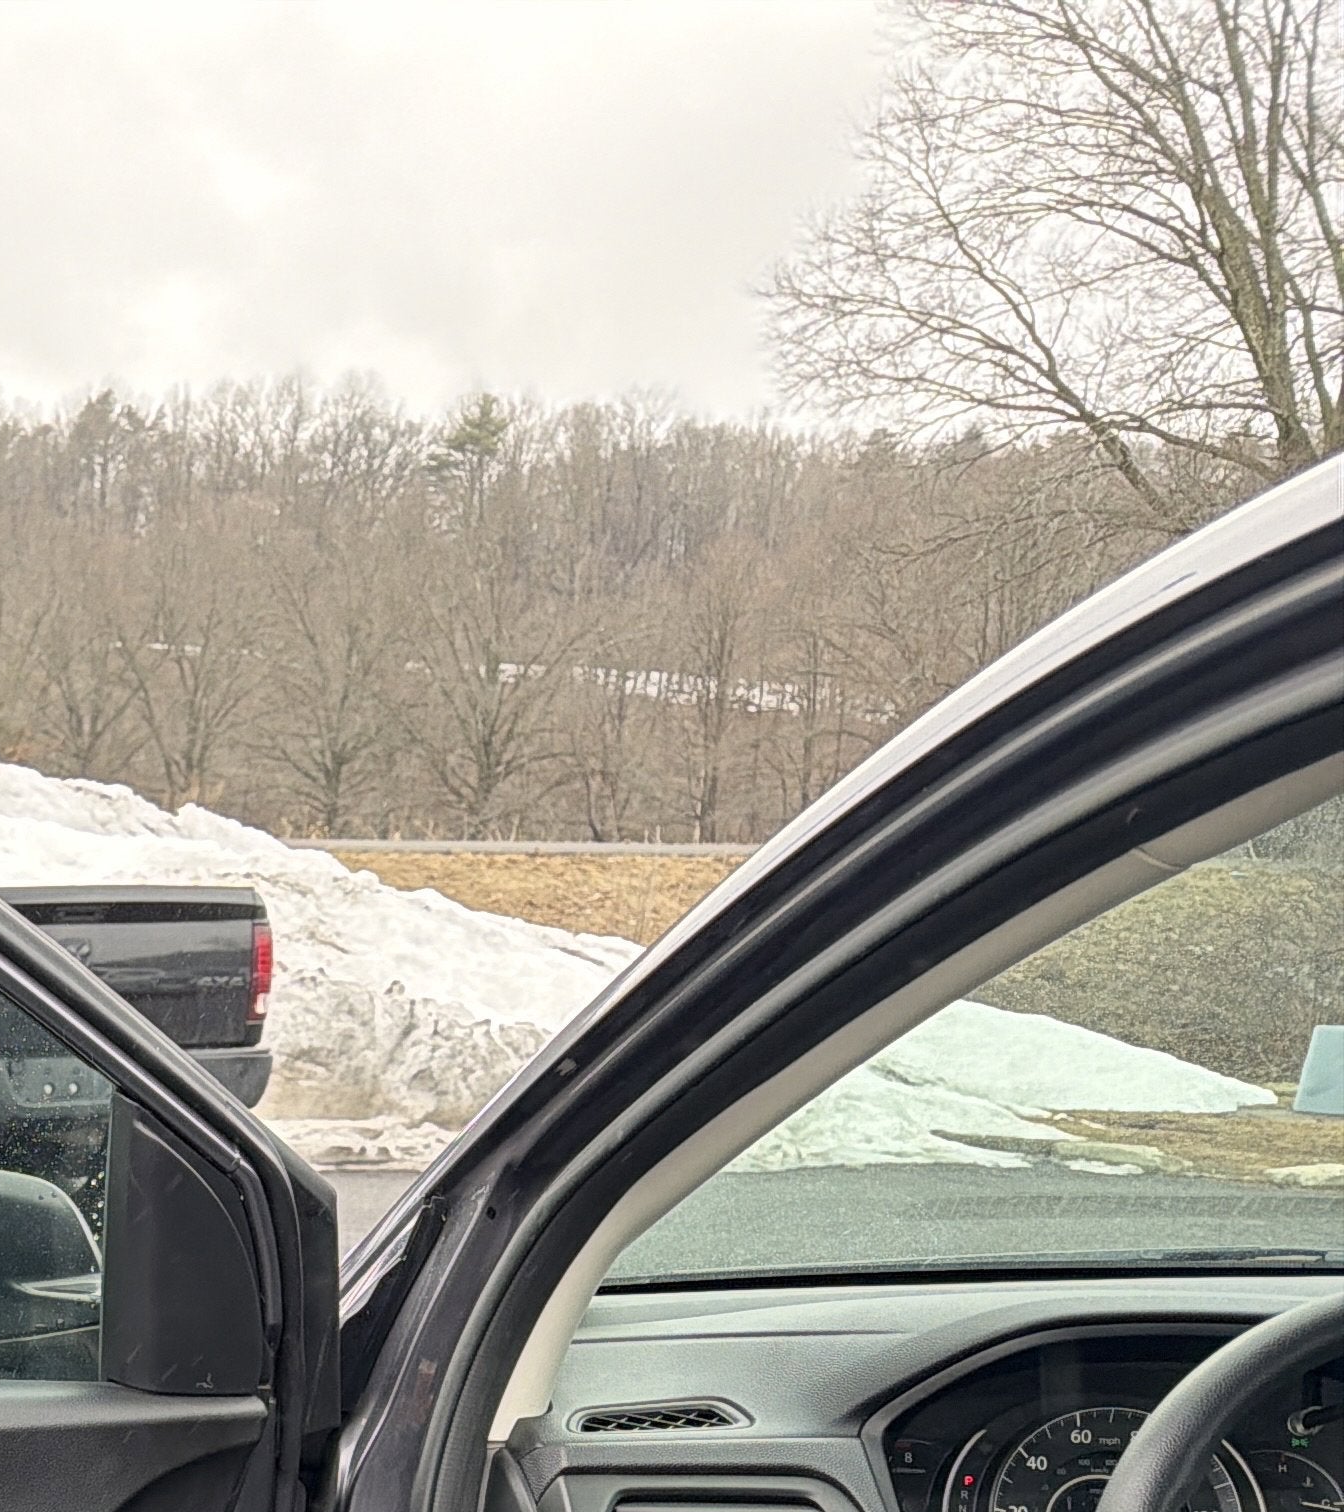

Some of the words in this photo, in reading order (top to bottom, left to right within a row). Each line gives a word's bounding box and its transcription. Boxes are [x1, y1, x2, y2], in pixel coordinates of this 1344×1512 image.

[1070, 1429, 1092, 1444] 60
[1098, 1437, 1121, 1445] mph
[1026, 1456, 1048, 1471] 40
[1278, 1464, 1288, 1473] H
[964, 1475, 974, 1486] P
[960, 1490, 969, 1500] R
